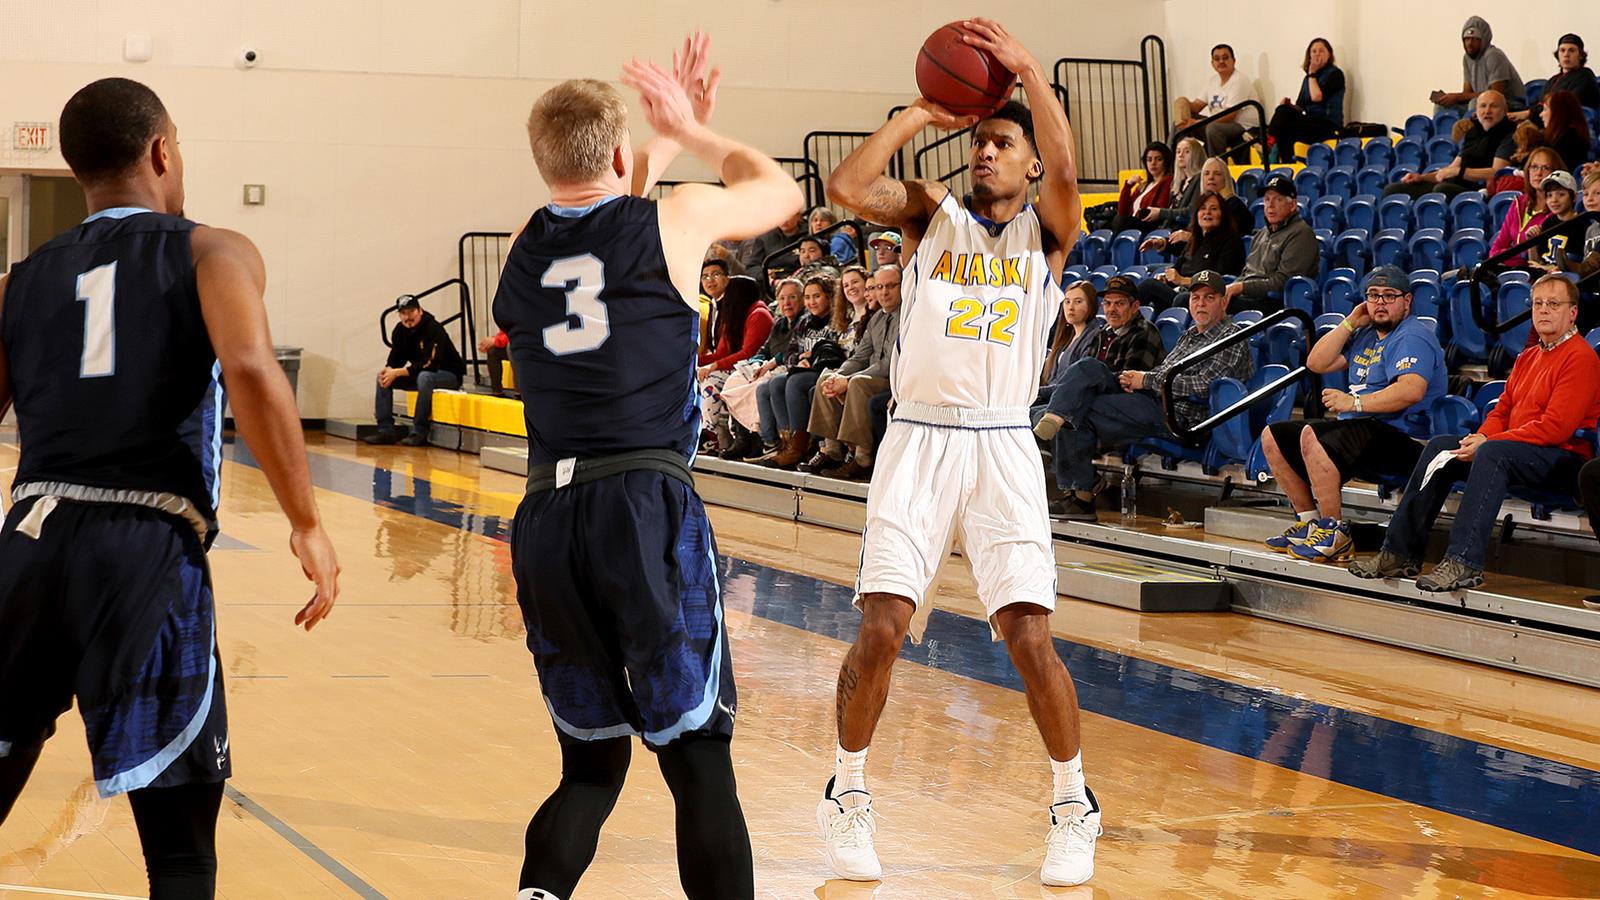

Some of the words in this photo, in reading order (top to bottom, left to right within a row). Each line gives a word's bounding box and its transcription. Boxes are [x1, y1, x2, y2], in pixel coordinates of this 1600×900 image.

[18, 127, 47, 146] EXIT
[76, 259, 118, 379] 1
[541, 253, 611, 356] 3
[945, 297, 1020, 347] 22
